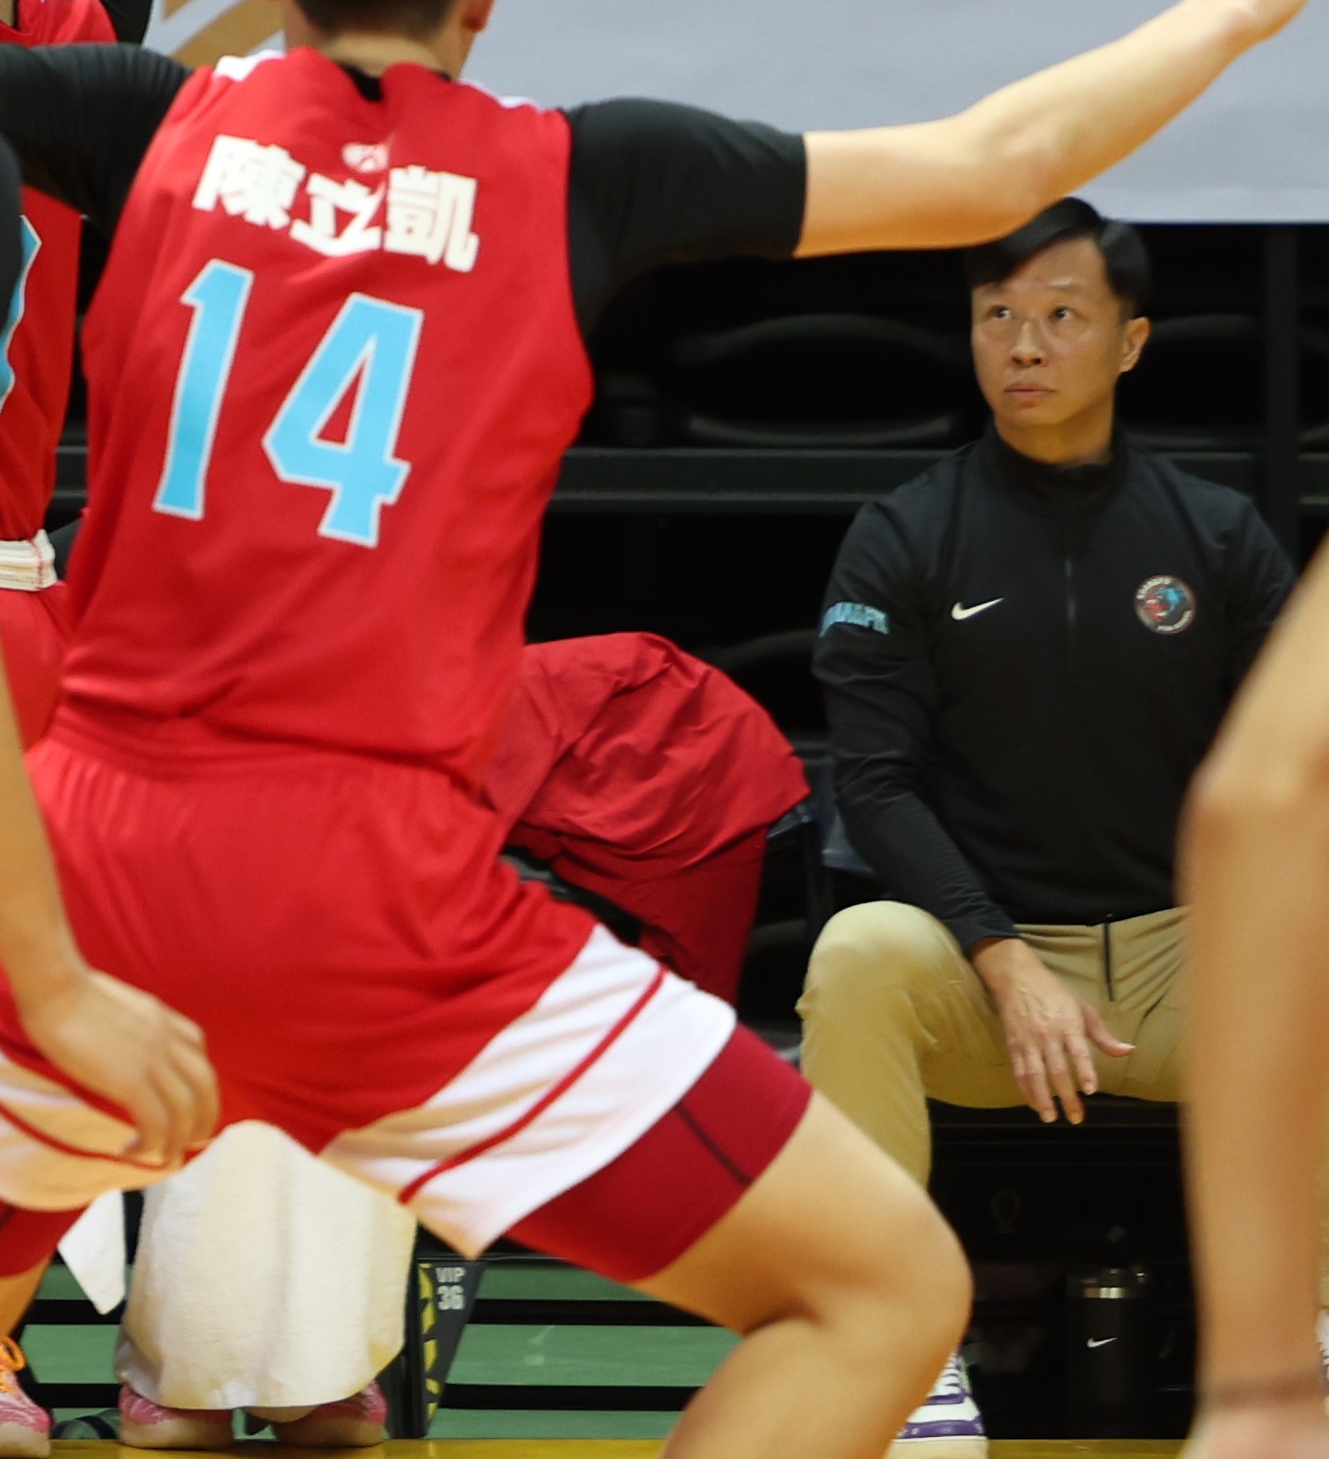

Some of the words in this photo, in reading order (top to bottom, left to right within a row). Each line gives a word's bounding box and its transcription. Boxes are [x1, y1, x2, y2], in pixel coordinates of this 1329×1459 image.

[192, 135, 479, 272] 陳立凱
[153, 258, 424, 549] 14
[435, 1266, 466, 1283] VIP
[437, 1285, 465, 1310] 36
